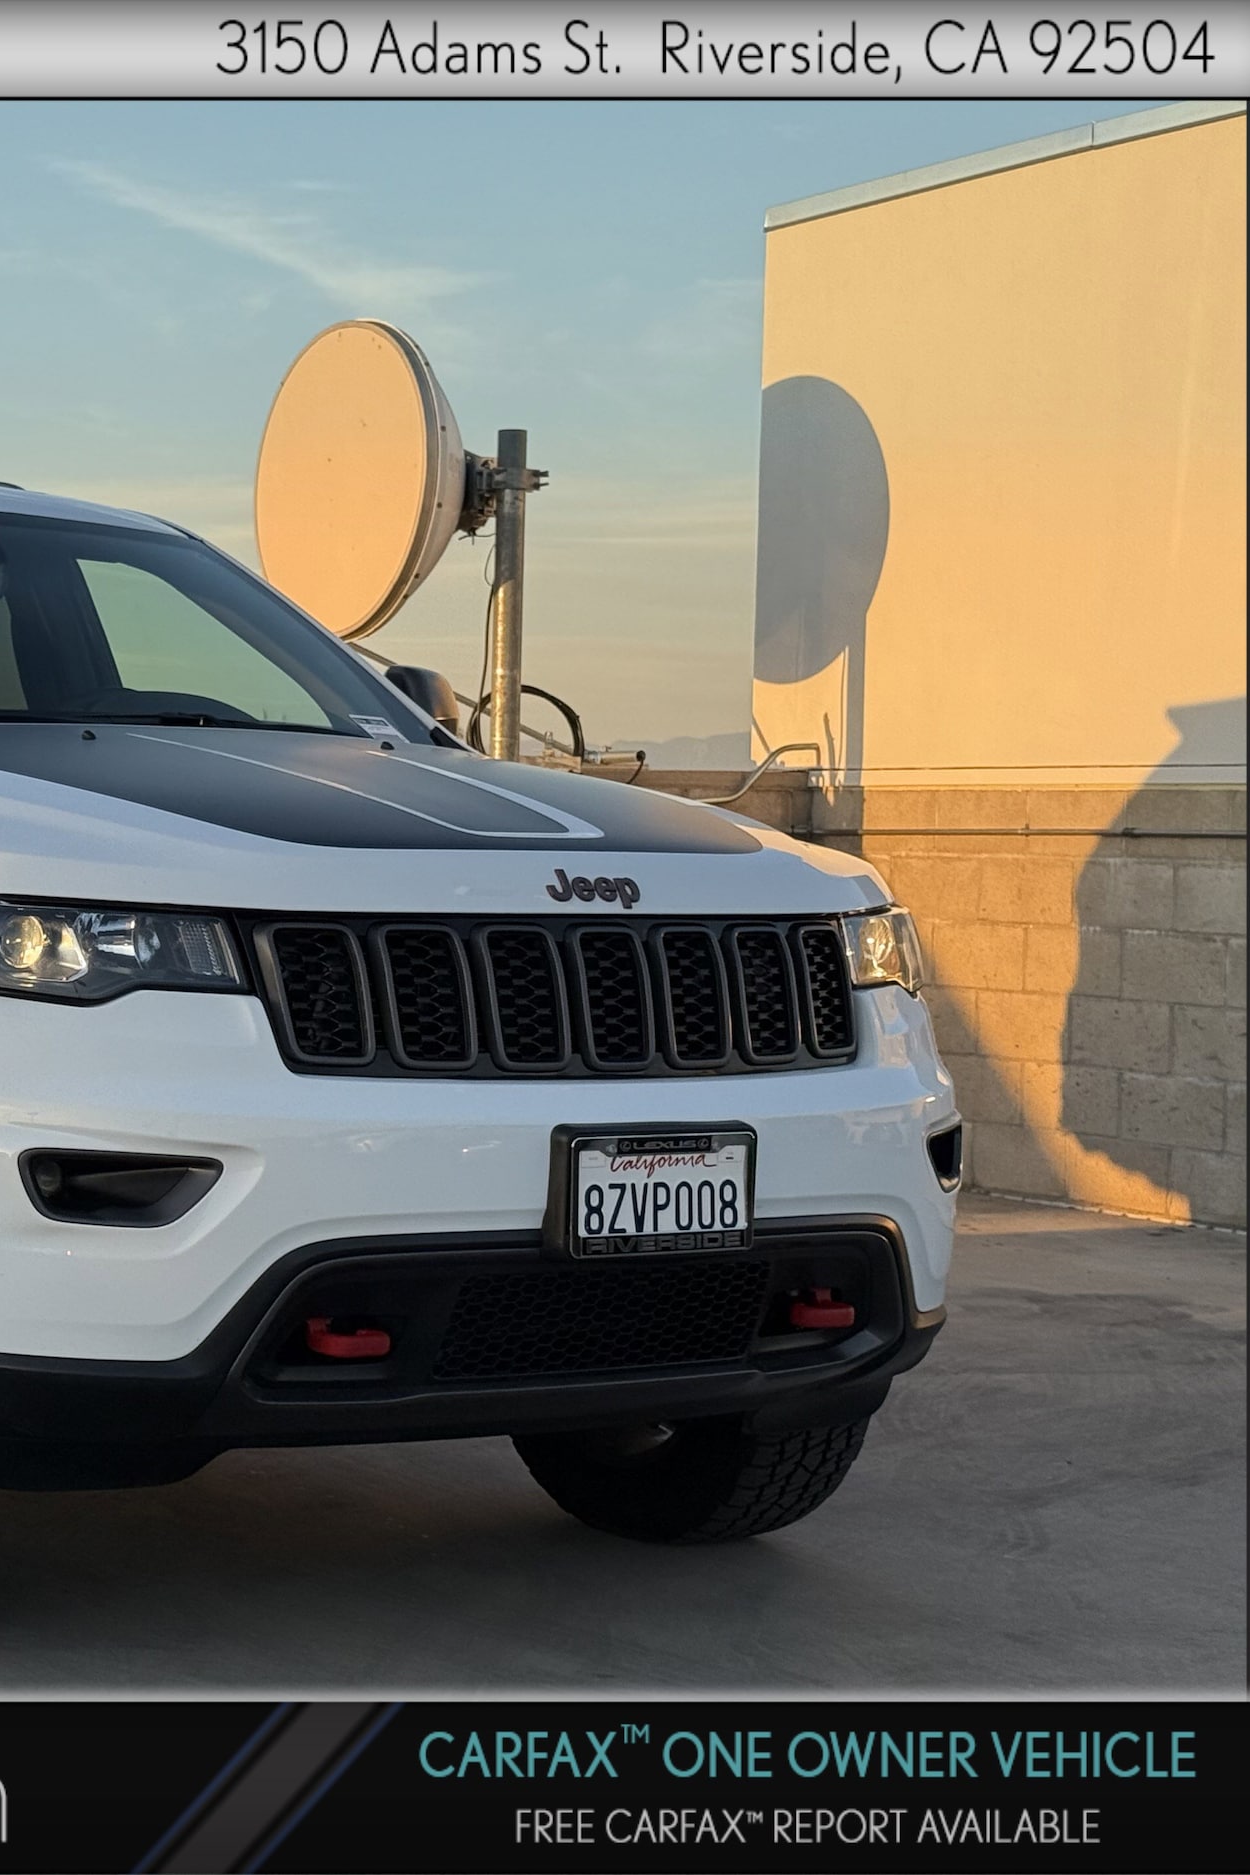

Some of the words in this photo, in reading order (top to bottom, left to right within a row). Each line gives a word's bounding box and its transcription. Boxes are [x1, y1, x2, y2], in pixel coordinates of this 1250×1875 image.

[546, 869, 640, 909] Jeep
[633, 1139, 697, 1151] LEXUS
[610, 1153, 717, 1178] California
[584, 1179, 739, 1235] 8ZVP008
[586, 1231, 742, 1254] RIVERSIDE
